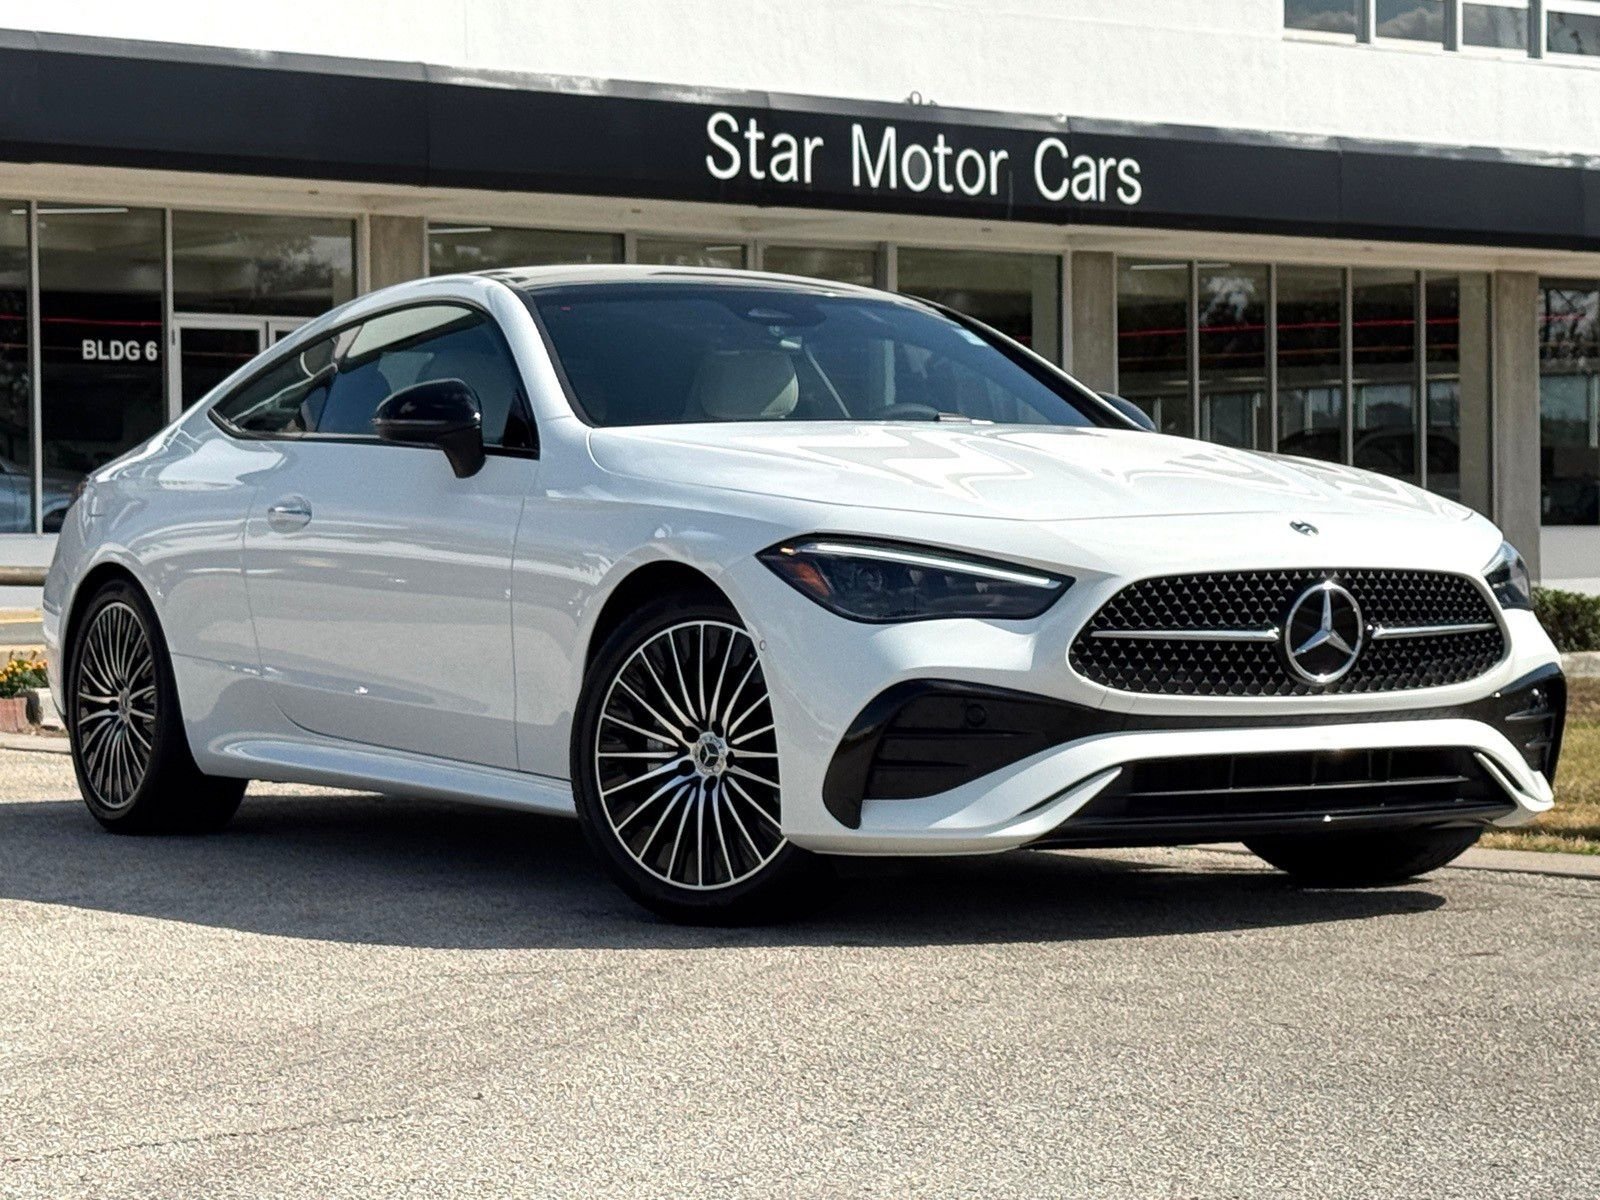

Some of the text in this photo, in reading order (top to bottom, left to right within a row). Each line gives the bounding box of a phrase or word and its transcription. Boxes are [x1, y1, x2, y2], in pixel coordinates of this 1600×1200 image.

[705, 111, 1142, 205] Star Motor Cars
[82, 339, 158, 361] BLDG 6
